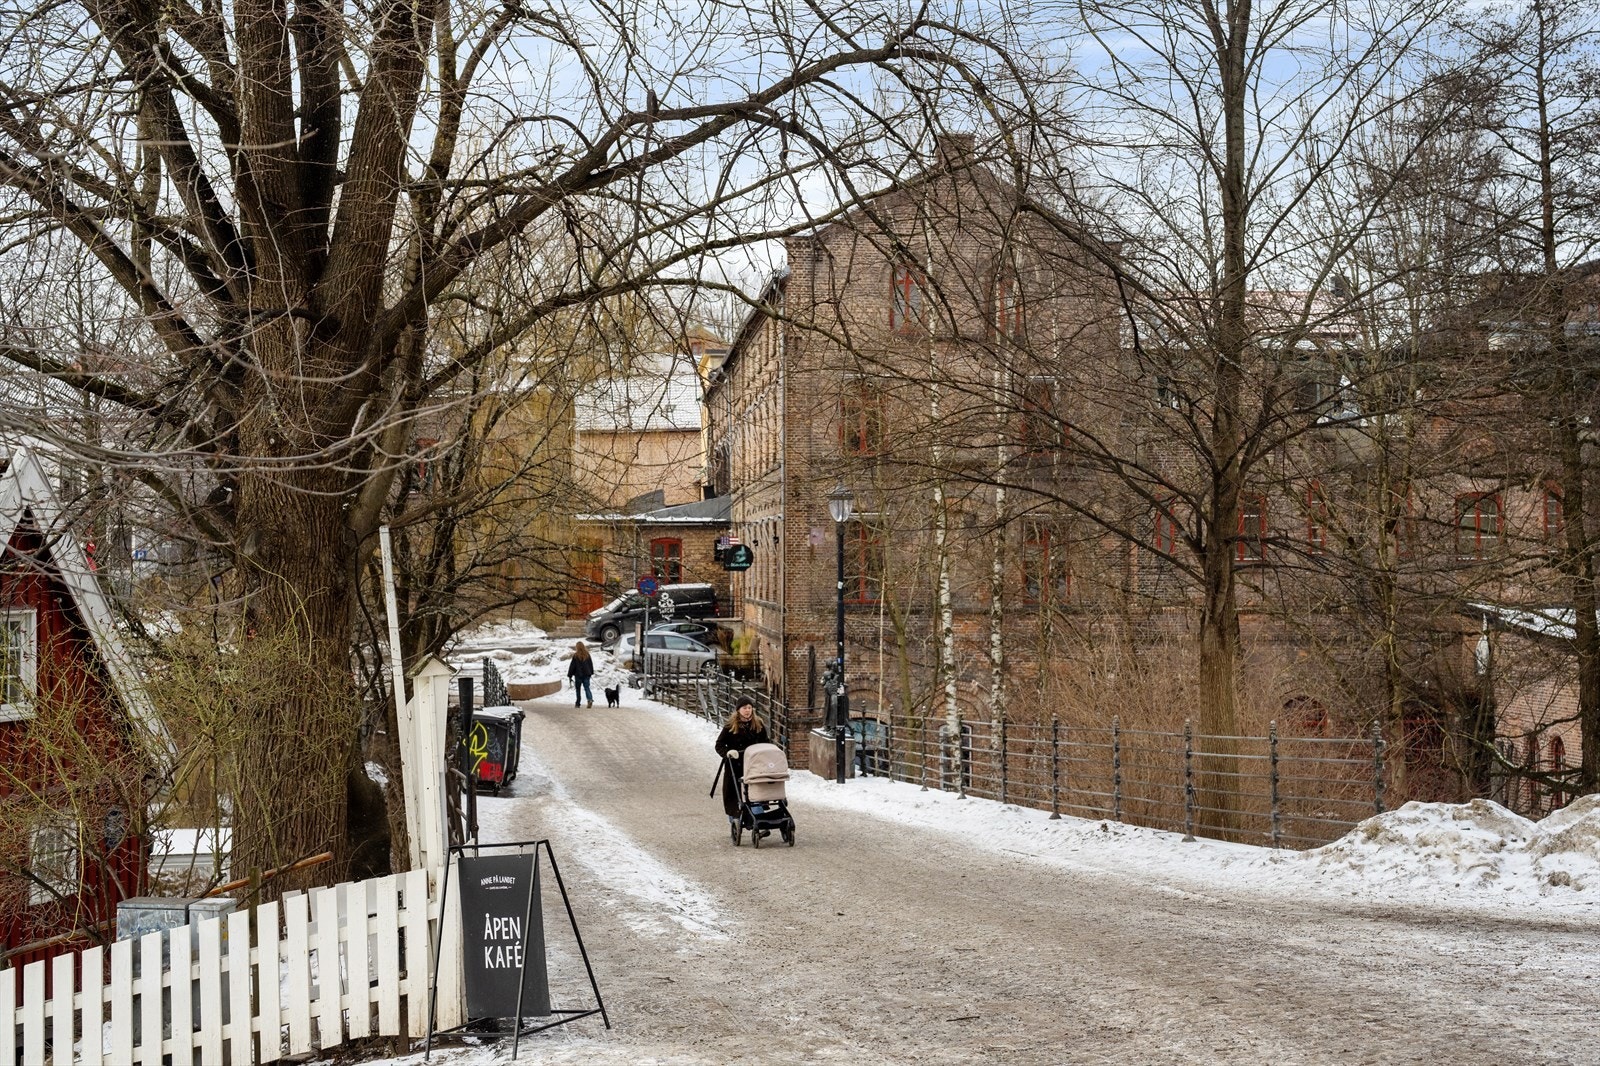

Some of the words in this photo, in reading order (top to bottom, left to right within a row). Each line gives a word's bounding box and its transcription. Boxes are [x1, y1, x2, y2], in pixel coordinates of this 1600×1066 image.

[480, 876, 493, 886] ANNE
[493, 875, 499, 883] PÅ
[499, 876, 515, 884] LANDET
[484, 913, 521, 940] ÅPEN
[484, 941, 523, 969] KAFÉ
